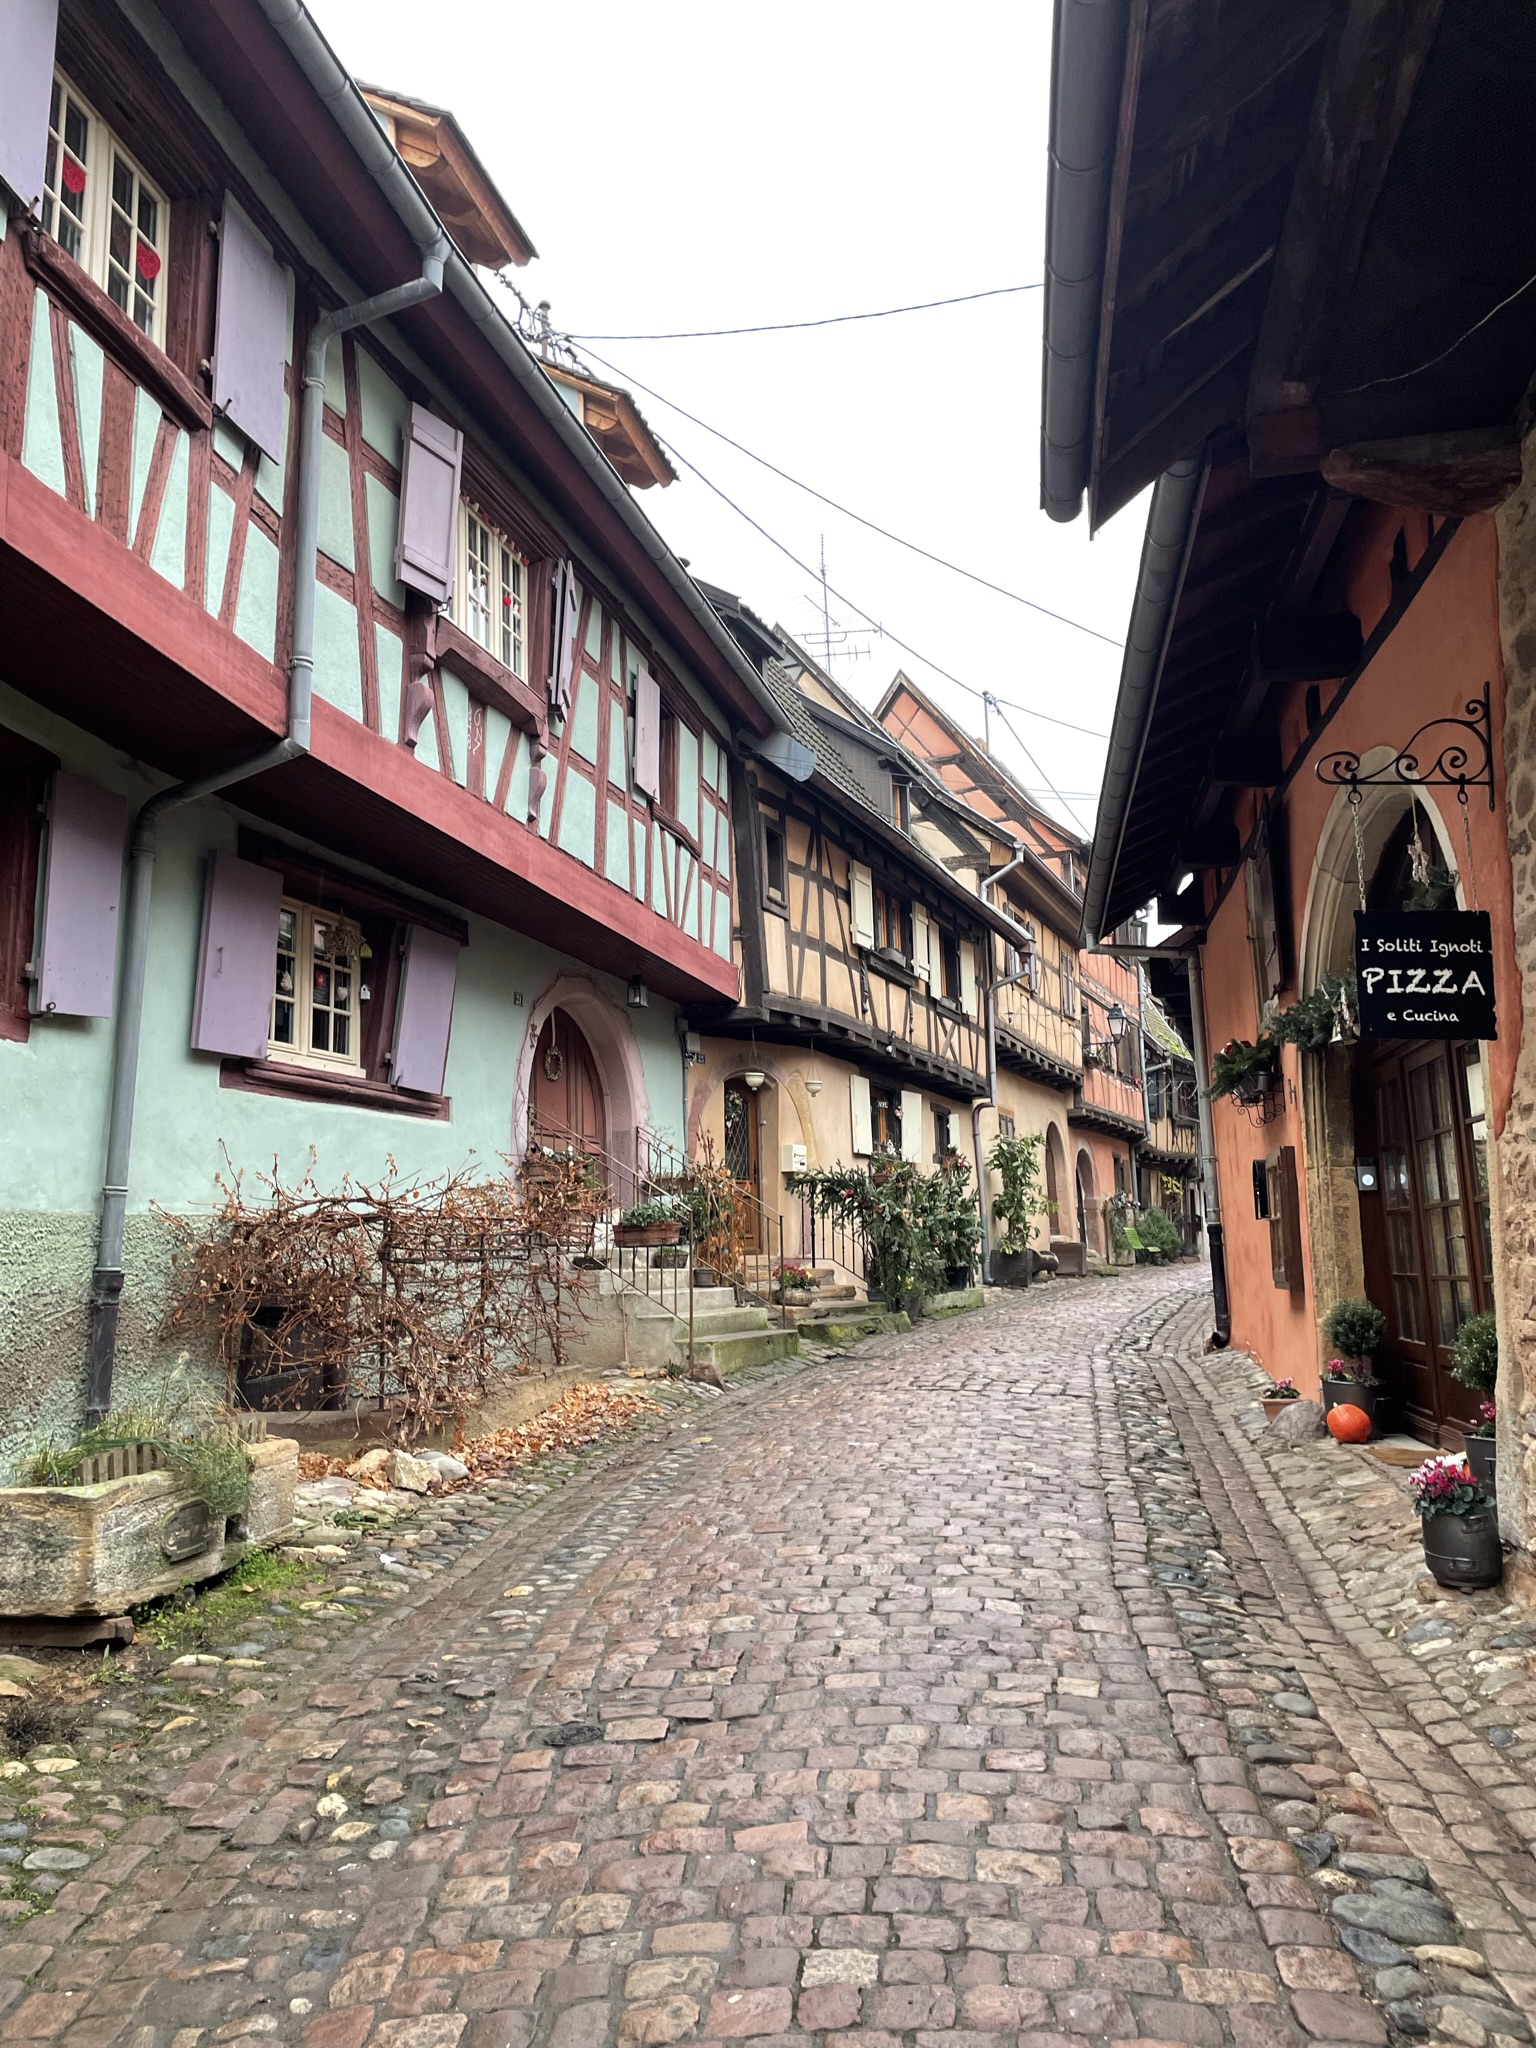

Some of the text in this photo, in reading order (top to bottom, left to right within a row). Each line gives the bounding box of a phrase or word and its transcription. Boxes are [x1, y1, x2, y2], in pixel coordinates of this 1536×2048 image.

[1361, 938, 1483, 957] I Soliti Ignoti
[1362, 967, 1485, 995] PIZZA
[1387, 1010, 1459, 1022] e Cucina
